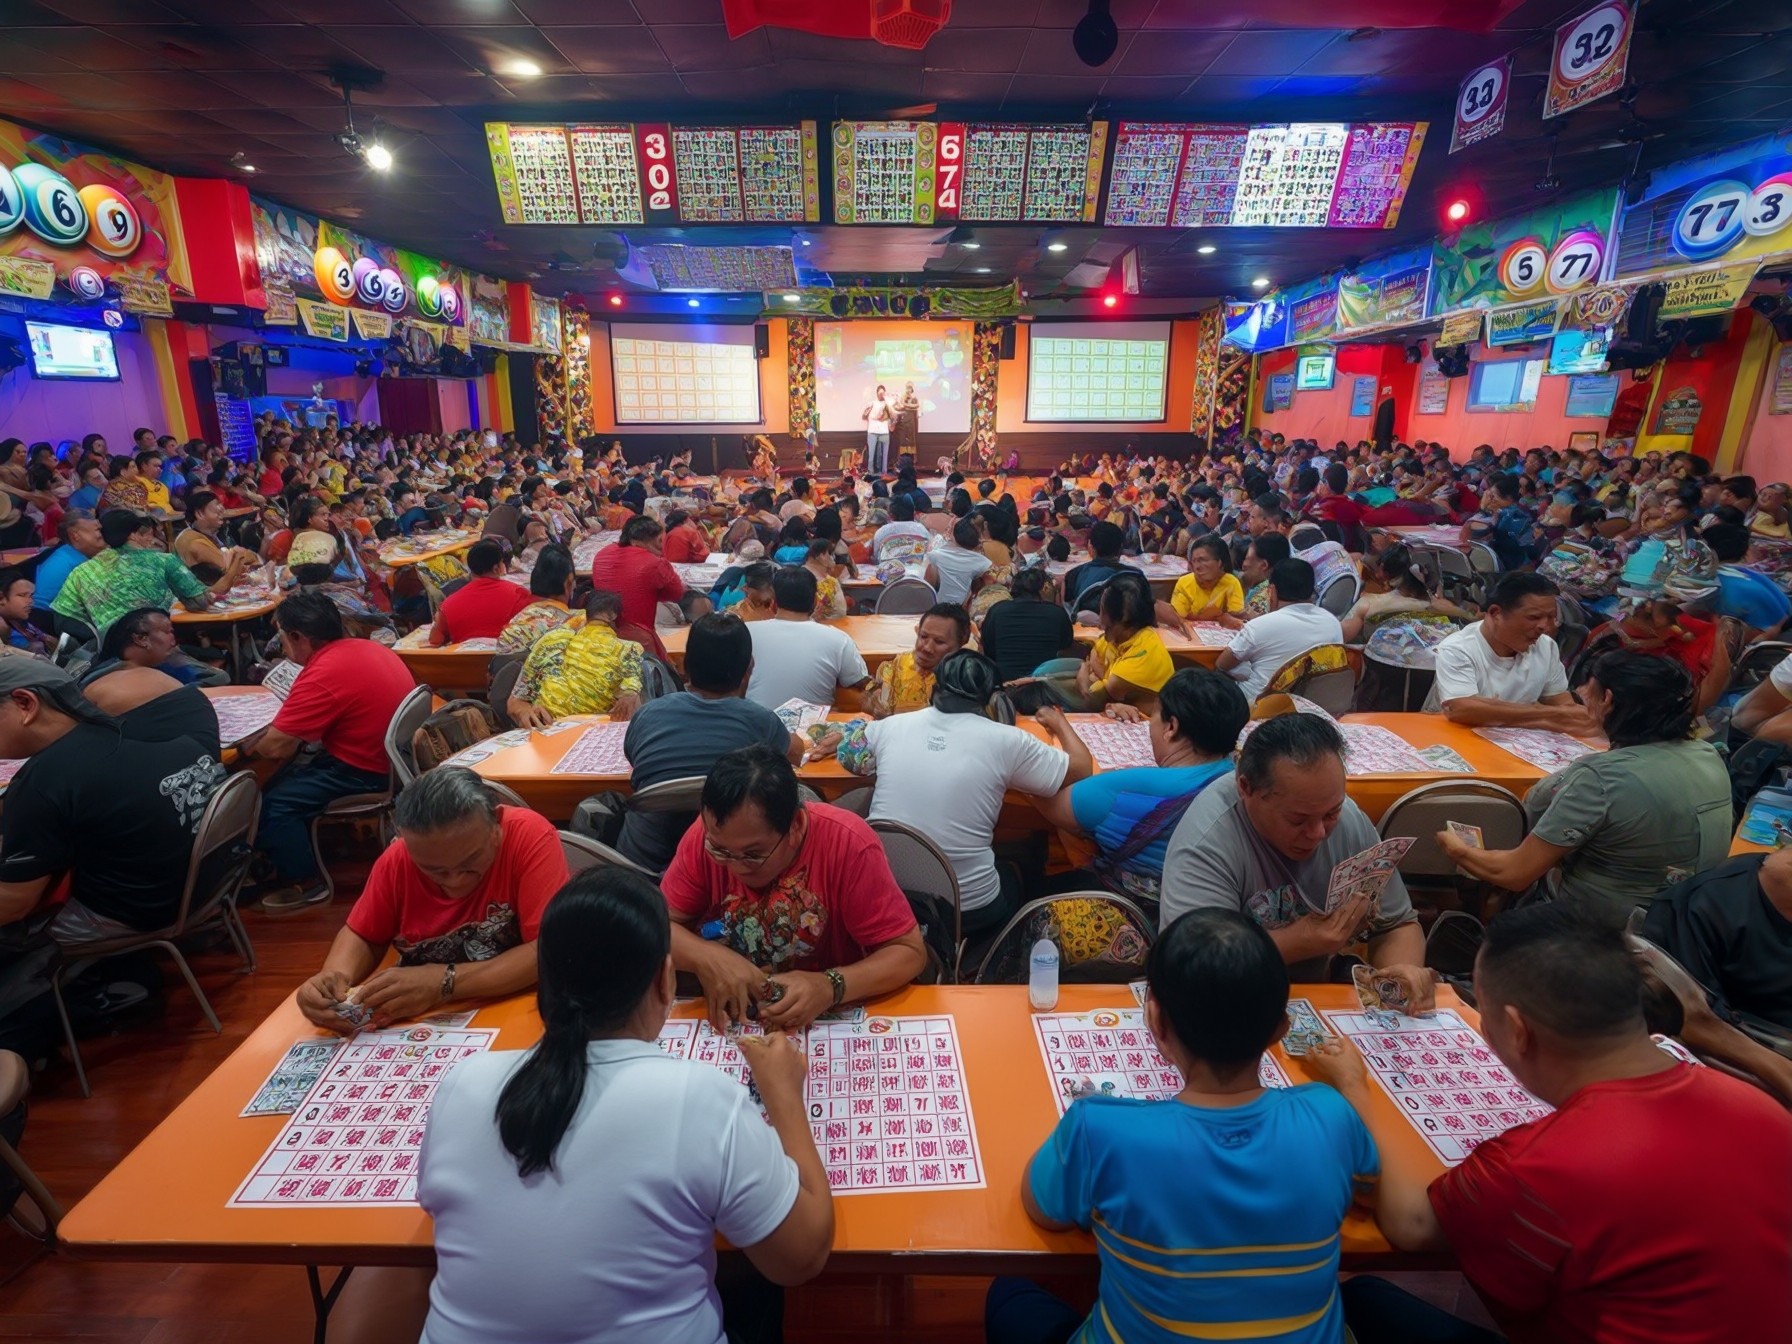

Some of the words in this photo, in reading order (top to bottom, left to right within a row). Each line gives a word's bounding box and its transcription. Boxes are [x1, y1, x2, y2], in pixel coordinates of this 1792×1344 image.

[52, 189, 77, 228] 6
[1688, 198, 1741, 238] 77
[337, 267, 350, 288] 3
